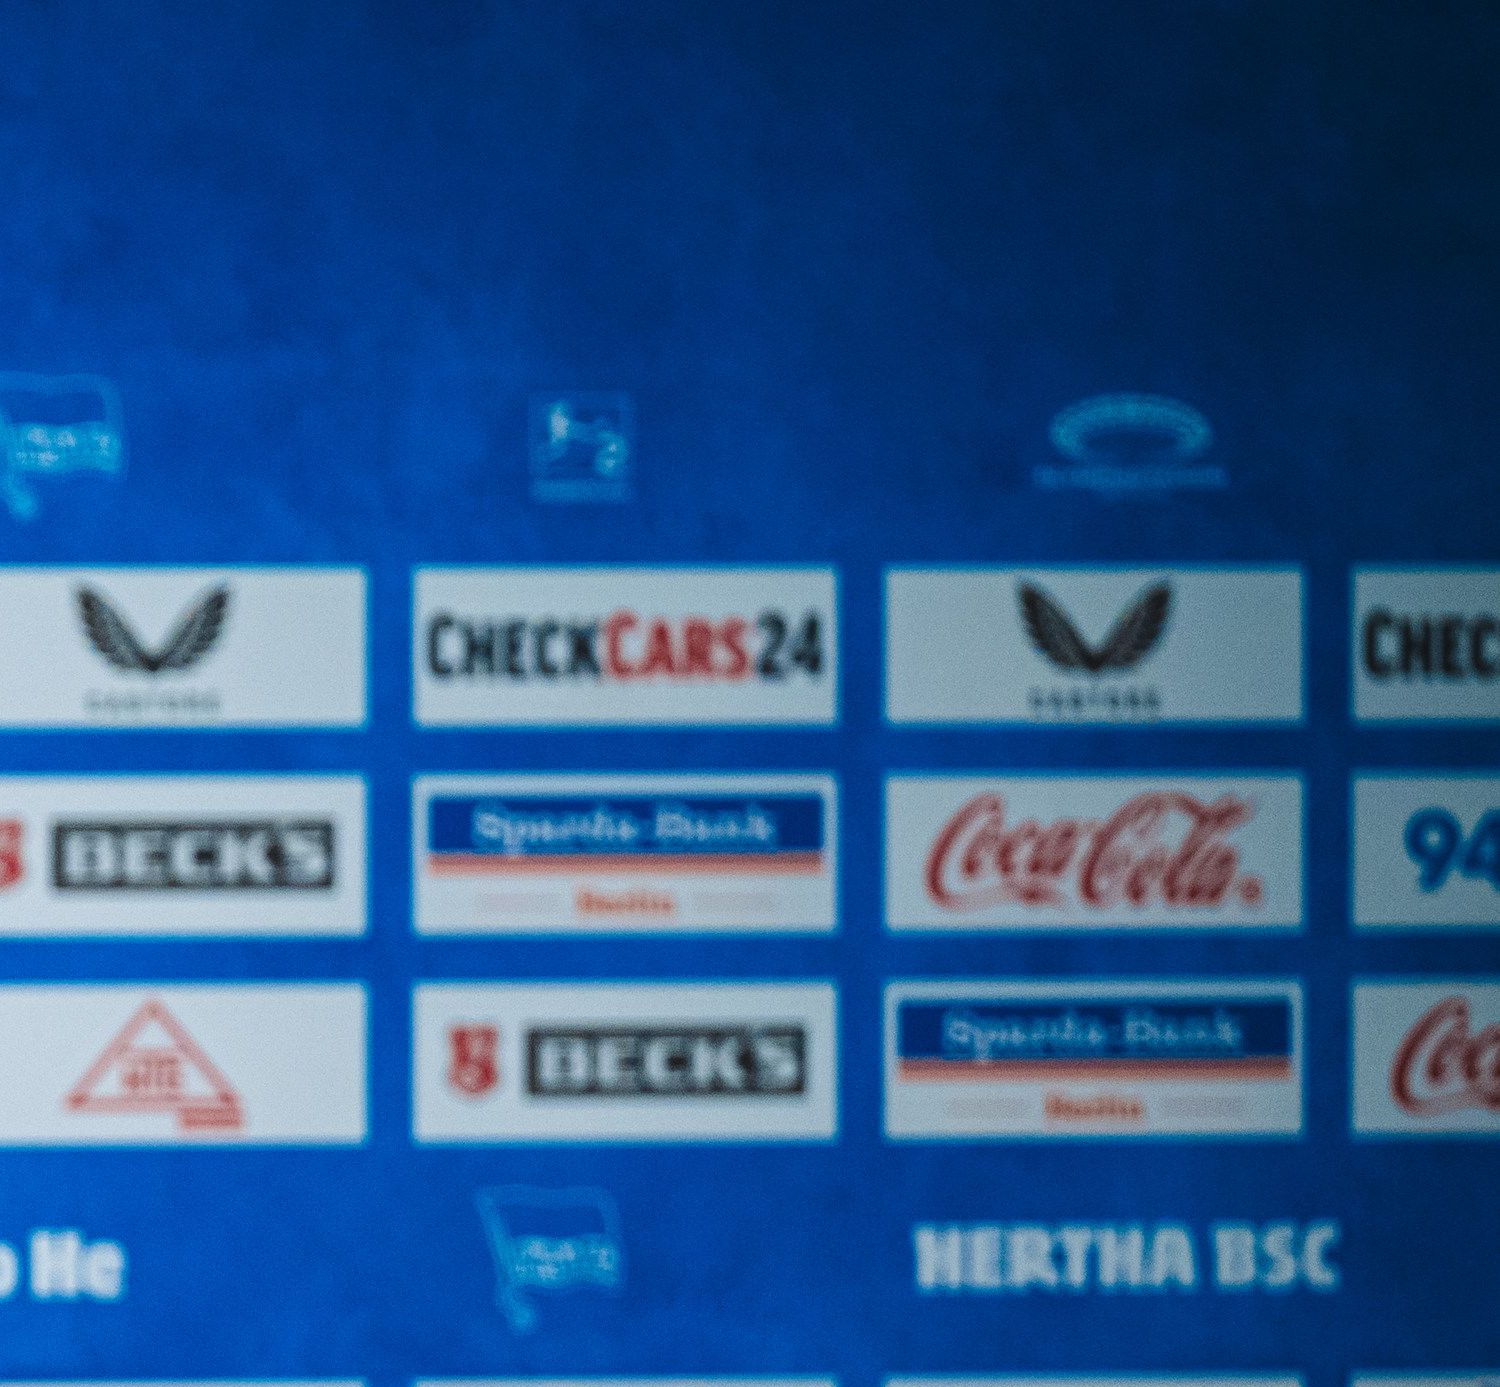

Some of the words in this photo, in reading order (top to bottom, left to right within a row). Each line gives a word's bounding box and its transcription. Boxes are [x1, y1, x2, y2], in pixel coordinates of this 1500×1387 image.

[29, 1230, 126, 1299] He
[913, 1224, 1196, 1292] HERTHA
[1211, 1224, 1338, 1290] BSC
